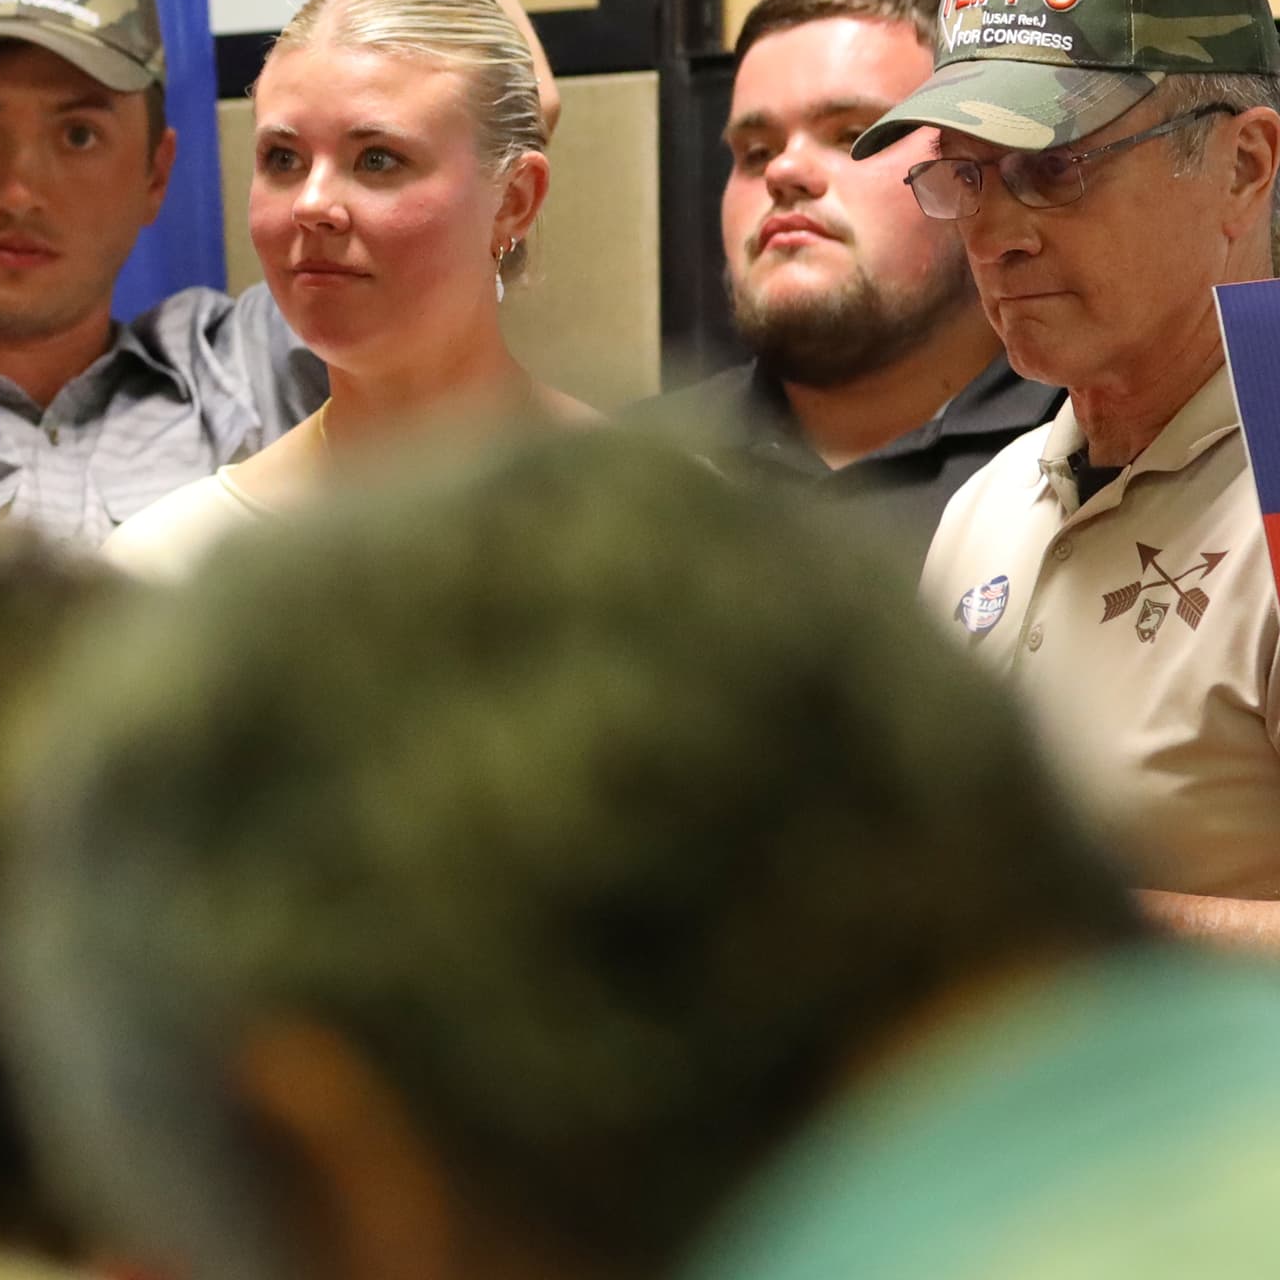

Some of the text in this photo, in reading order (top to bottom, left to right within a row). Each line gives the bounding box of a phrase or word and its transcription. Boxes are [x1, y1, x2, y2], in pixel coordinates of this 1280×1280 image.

[982, 10, 1048, 29] (USAF Ret.)
[956, 27, 1074, 52] FOR CONGRESS
